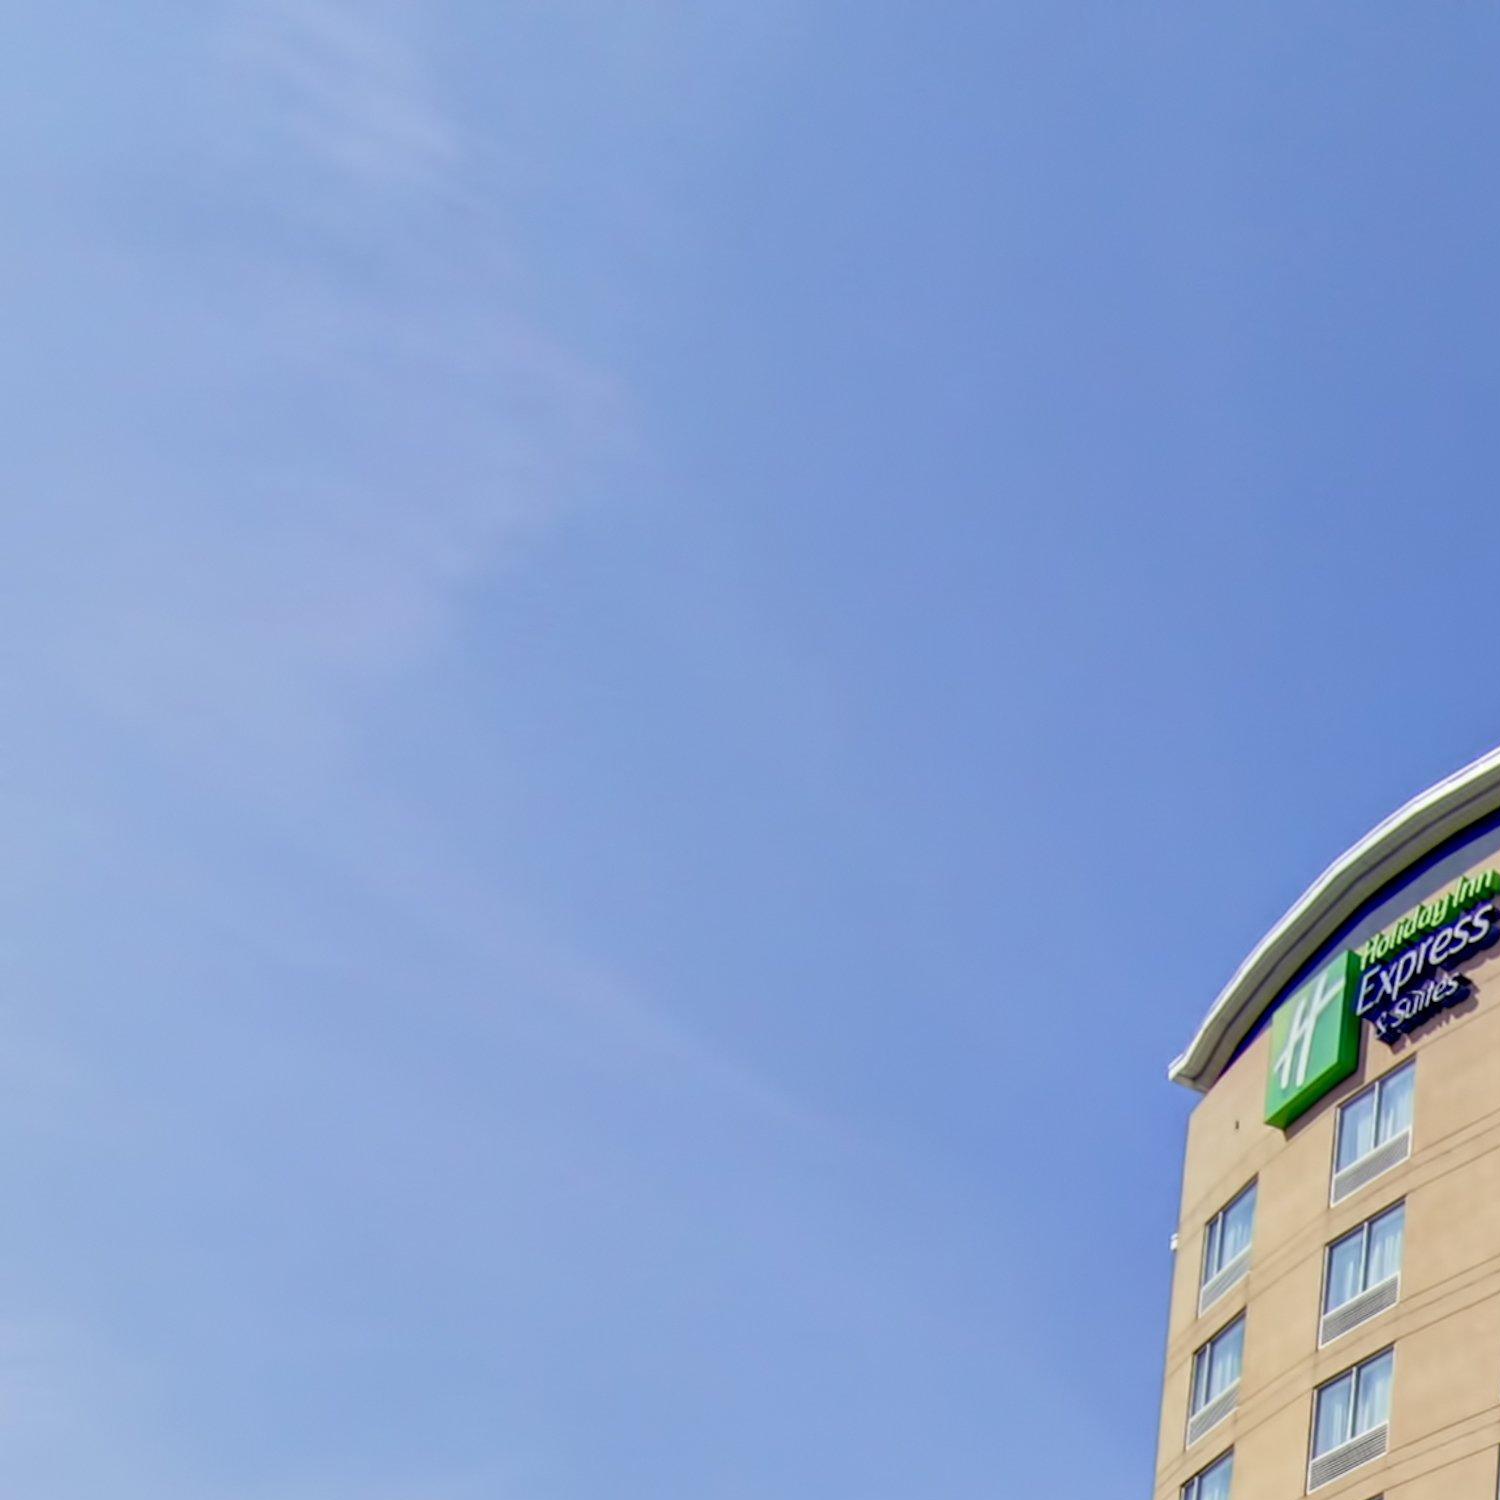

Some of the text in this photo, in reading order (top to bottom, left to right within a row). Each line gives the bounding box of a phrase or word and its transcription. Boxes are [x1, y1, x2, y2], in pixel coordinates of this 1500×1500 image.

[1357, 904, 1494, 1016] Express
[1360, 870, 1494, 970] Holiday Inn
[1390, 972, 1460, 1028] Suites
